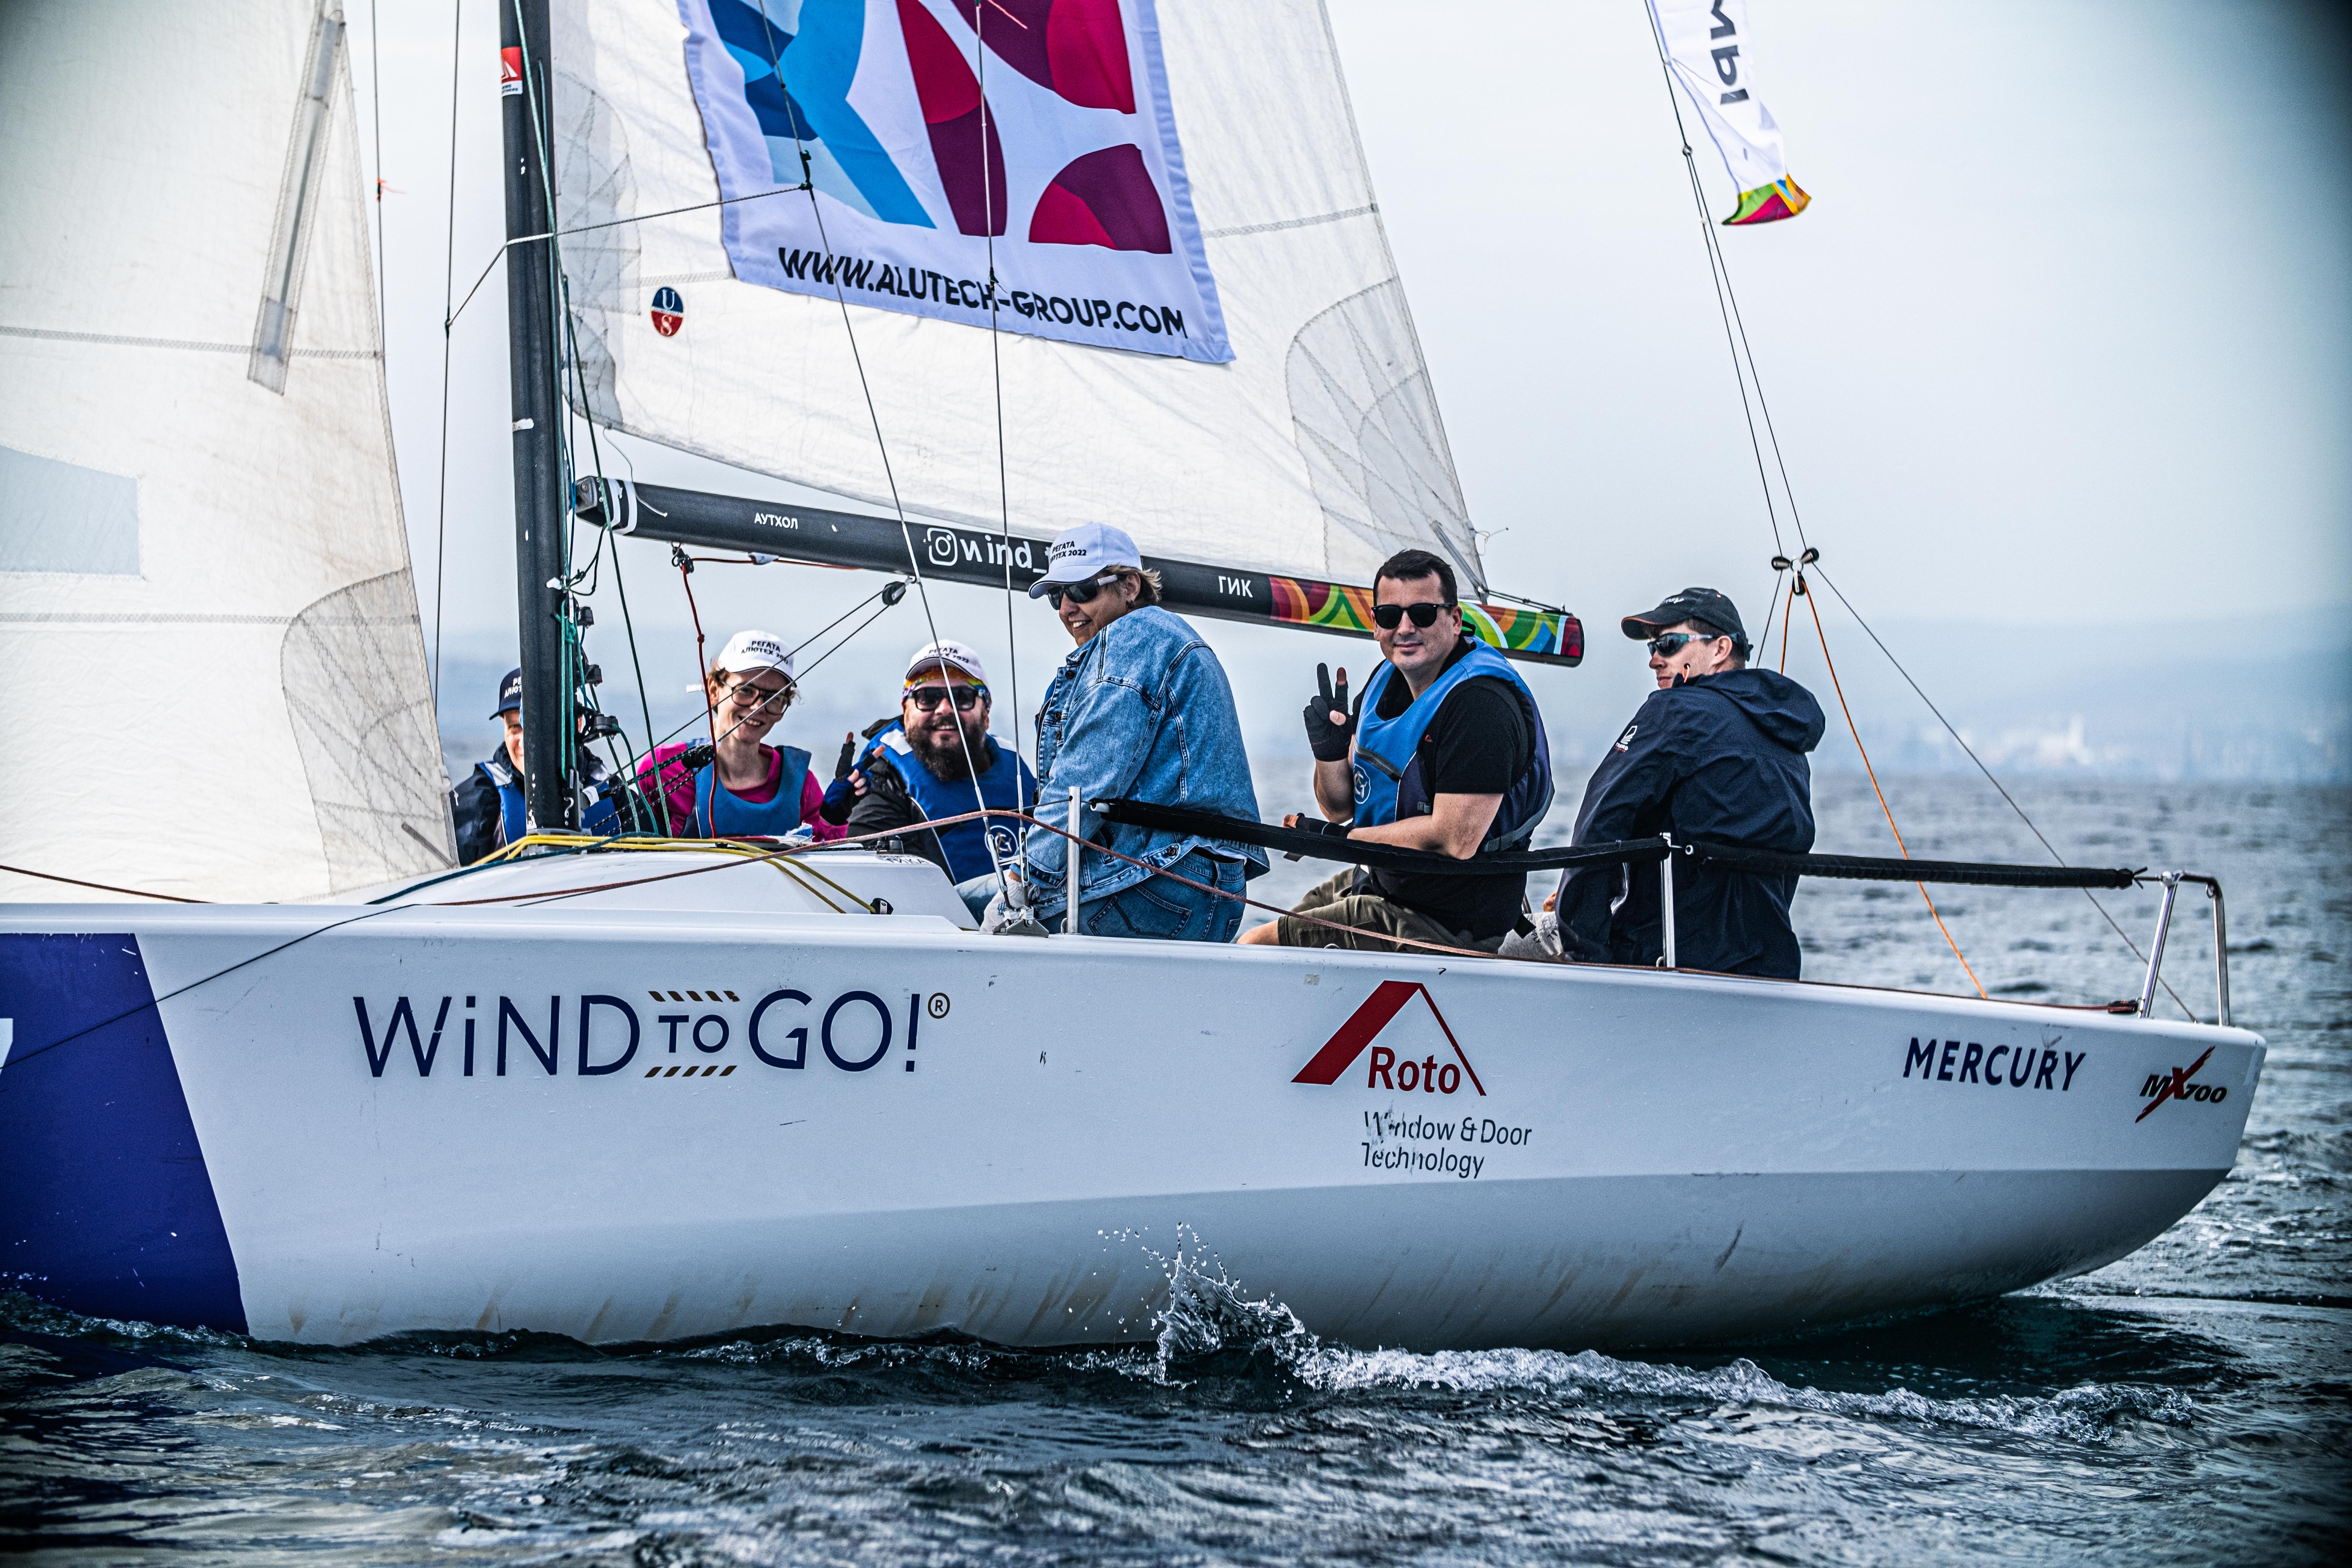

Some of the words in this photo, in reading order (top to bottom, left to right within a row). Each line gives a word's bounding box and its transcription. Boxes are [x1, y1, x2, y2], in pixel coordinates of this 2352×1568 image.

[778, 247, 1188, 339] WWW.ALUTECH-GROUP.COM
[754, 513, 798, 530] АУТХОЛ
[1052, 541, 1075, 554] РЕГАТА
[1218, 575, 1253, 598] ГИК
[741, 647, 773, 655] АЛЮТЕХ
[752, 641, 780, 652] РЕГАТА
[658, 1014, 730, 1054] TO
[1367, 1046, 1461, 1095] Roto
[1903, 1037, 2086, 1092] MERCURY
[1460, 1117, 1478, 1142] &
[1481, 1119, 1532, 1145] Door
[1361, 1142, 1484, 1179] Technology
